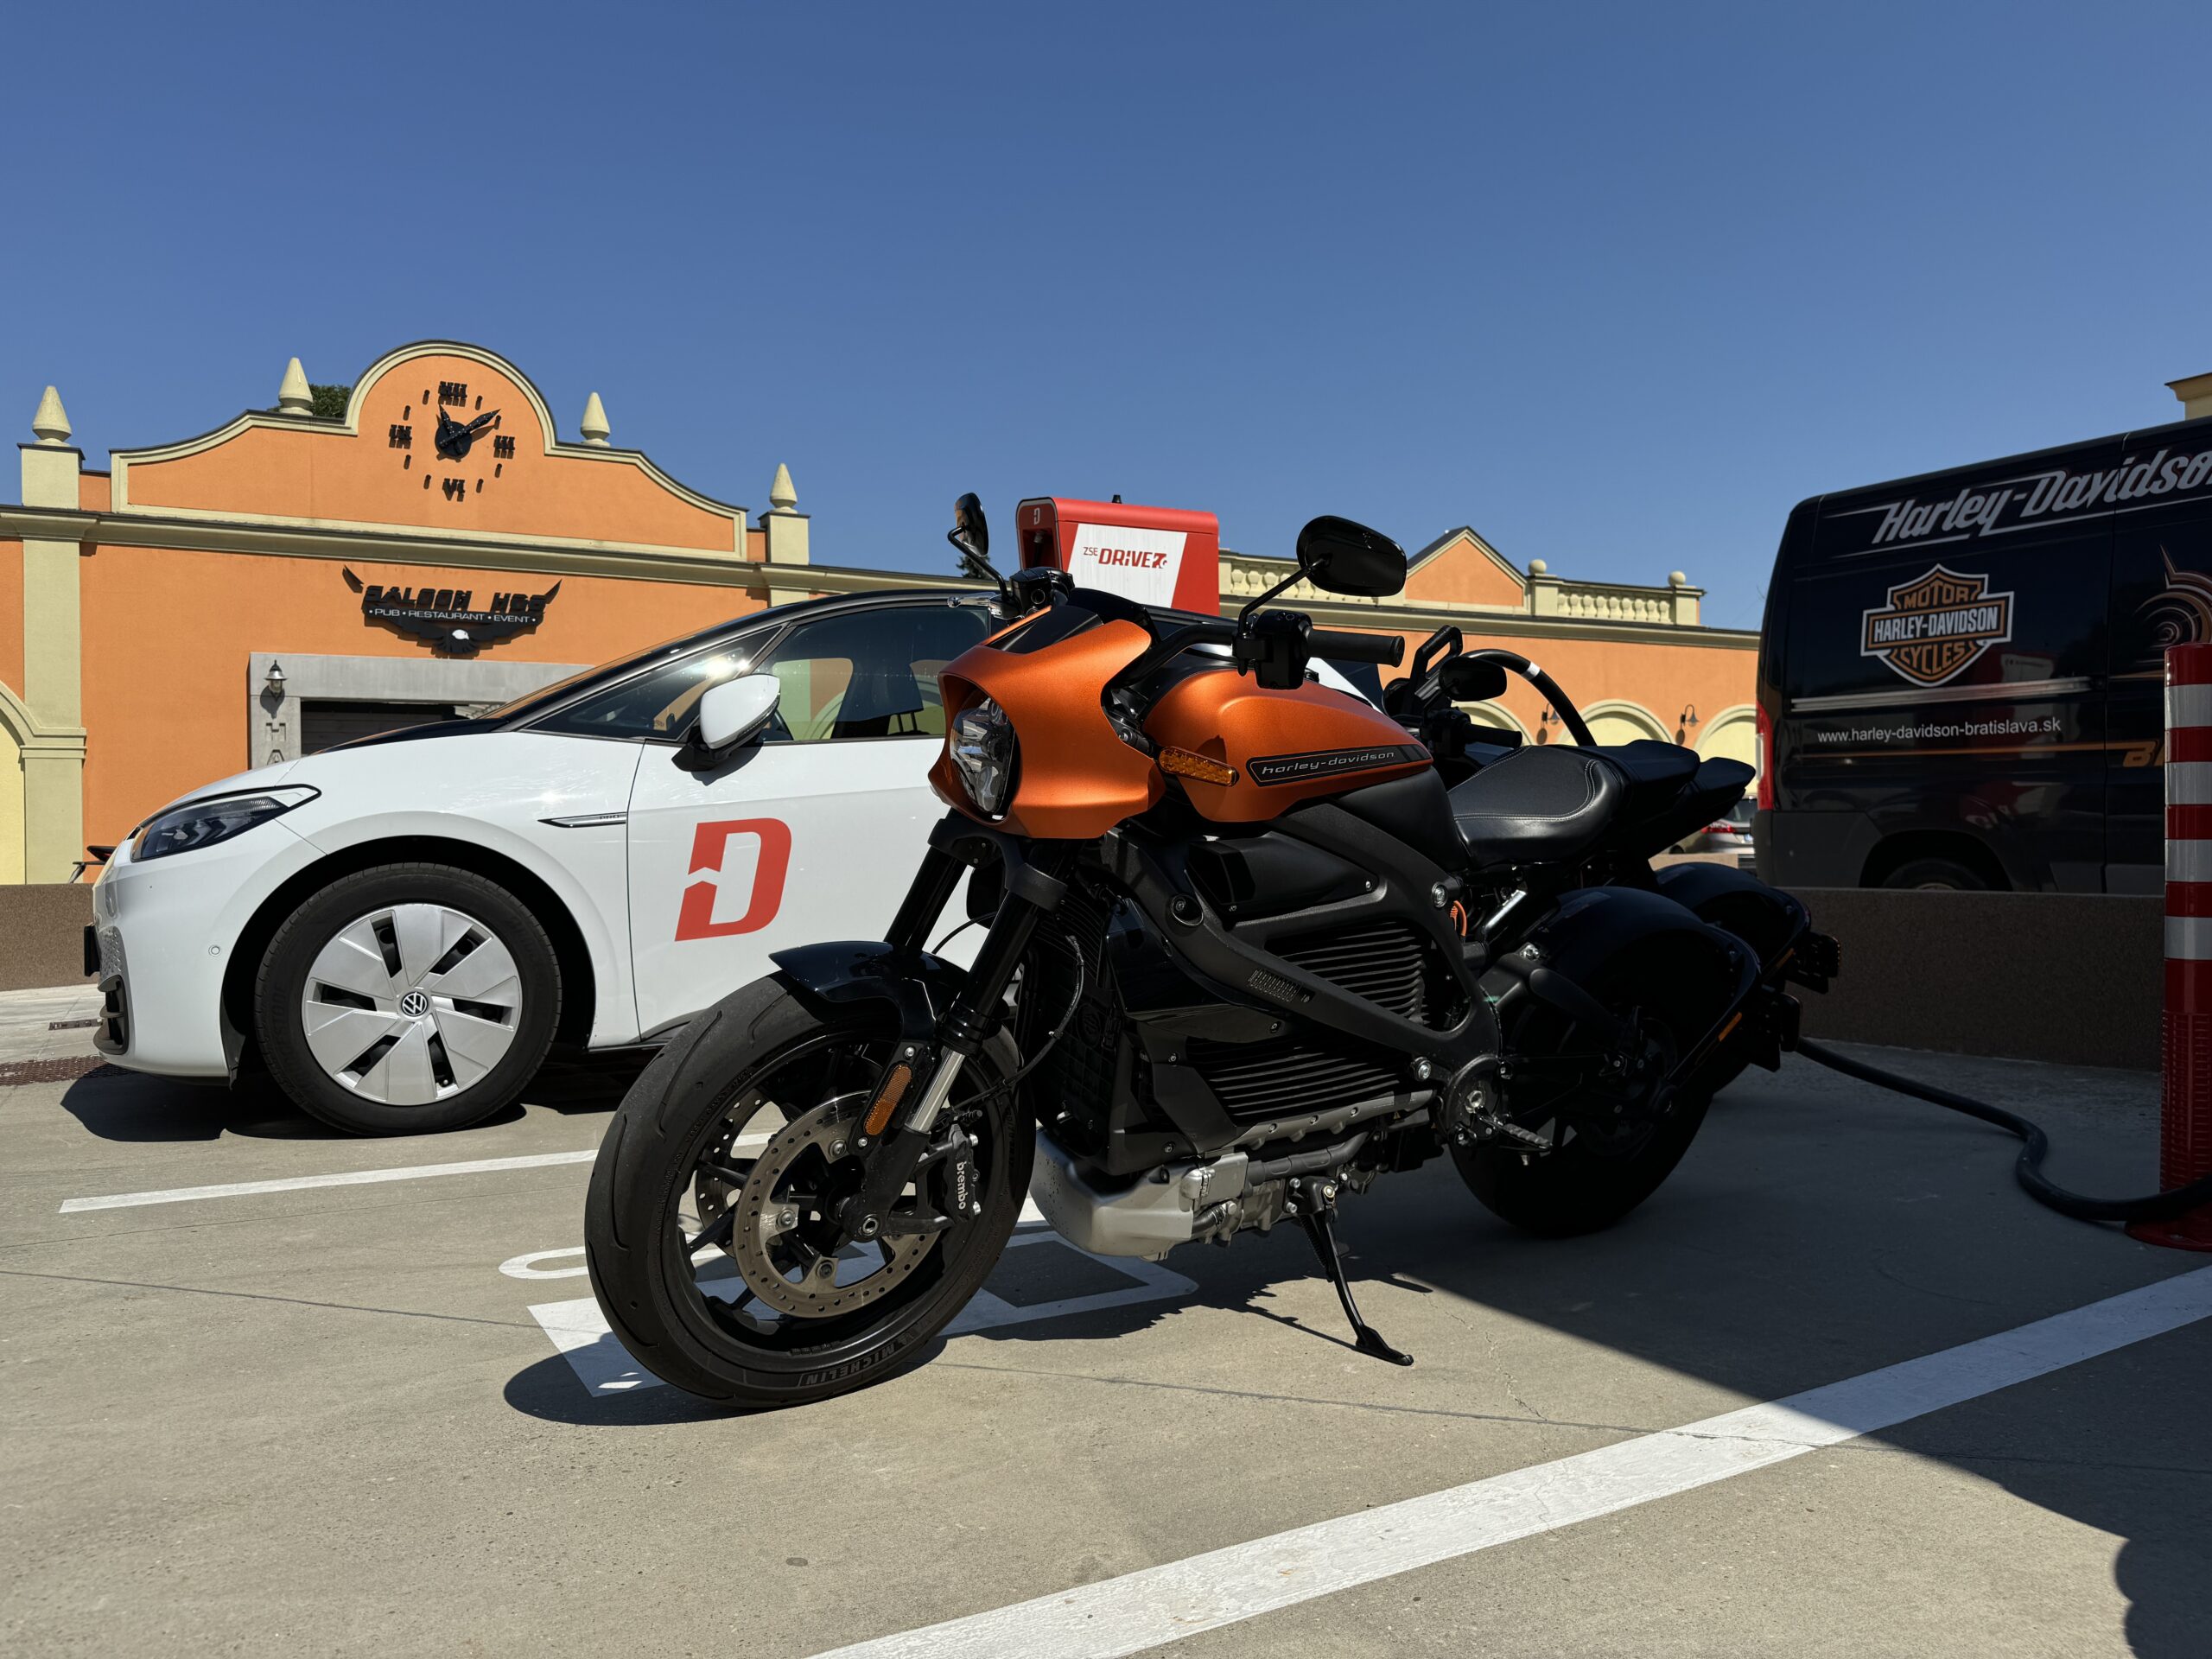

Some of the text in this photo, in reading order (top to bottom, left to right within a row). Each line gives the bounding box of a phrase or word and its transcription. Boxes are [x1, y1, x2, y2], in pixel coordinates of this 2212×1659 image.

[1872, 449, 2212, 544] Harley-Davidso
[1083, 546, 1098, 556] ZSE
[364, 585, 472, 610] SALOON
[1904, 579, 1971, 609] MOTOR
[374, 607, 531, 623] PUB RESTAURANT EVENT
[1874, 607, 1999, 642] HARLEY-DAVIDSON
[1900, 641, 1966, 675] CYCLES
[1817, 716, 2062, 743] www.harley-davidson-bratislava.sk
[1262, 752, 1395, 775] harley-davidson
[957, 1160, 968, 1210] brembo
[807, 1344, 895, 1385] MICHELIN
